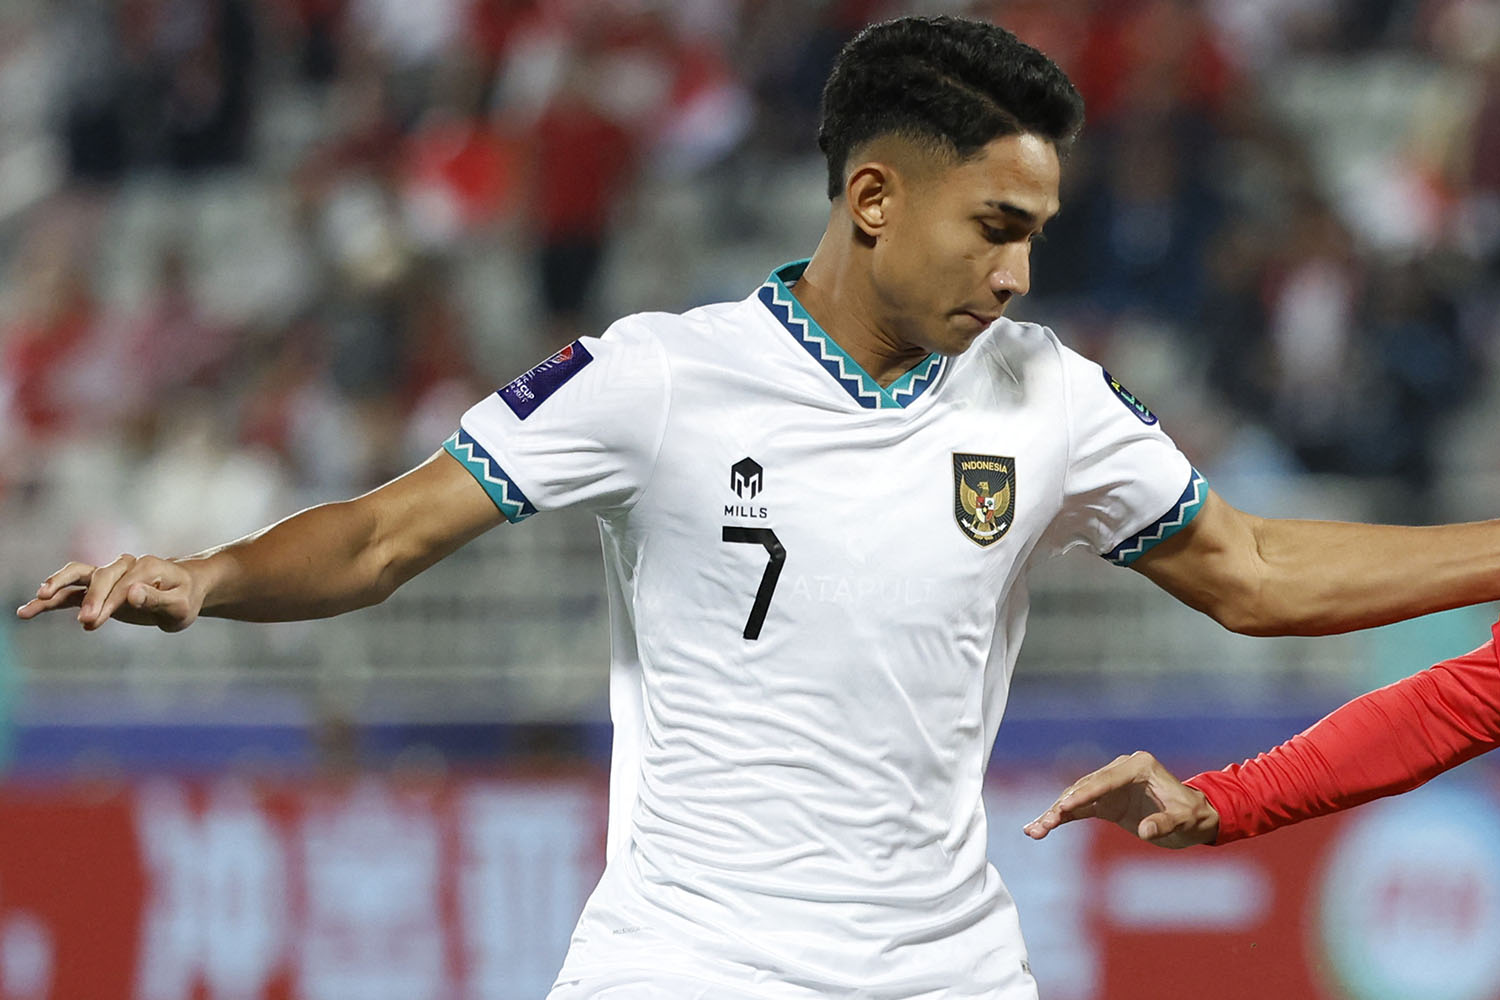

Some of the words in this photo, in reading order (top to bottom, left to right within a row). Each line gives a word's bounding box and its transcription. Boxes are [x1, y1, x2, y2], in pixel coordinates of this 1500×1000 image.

[961, 460, 1009, 475] INDONESIA
[724, 505, 768, 519] MILLS
[722, 525, 787, 641] 7
[782, 574, 937, 606] ATAPULT
